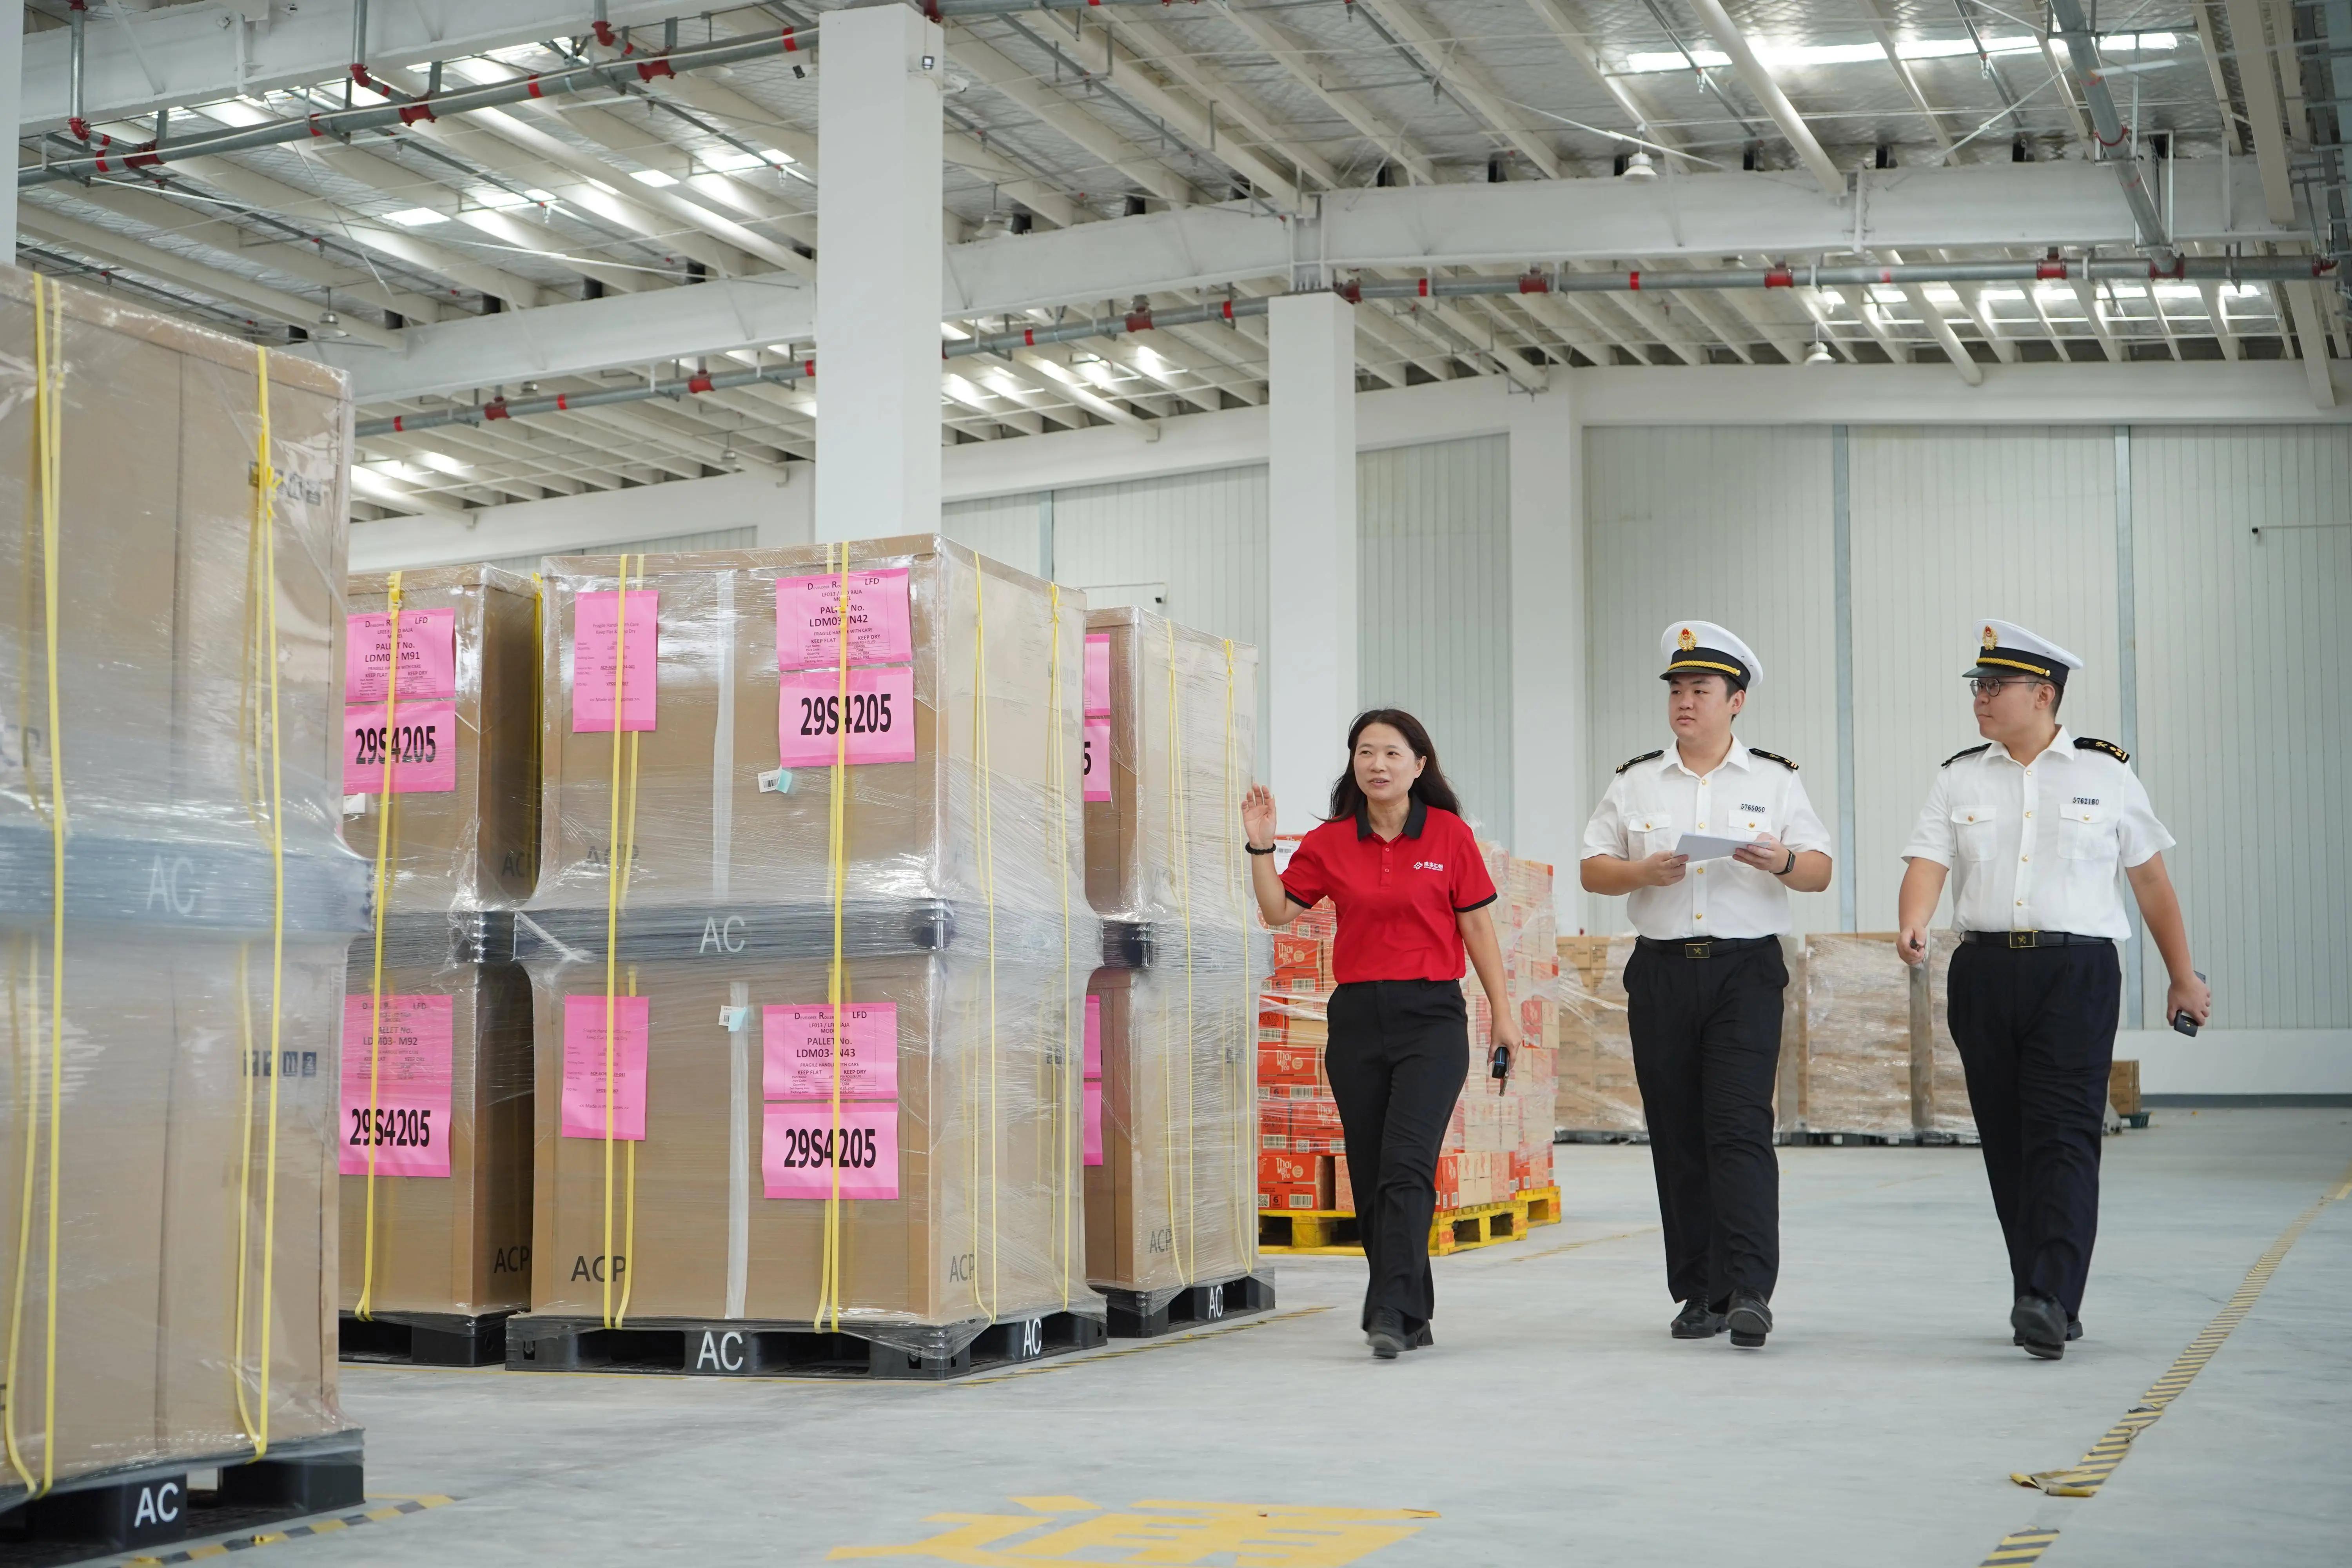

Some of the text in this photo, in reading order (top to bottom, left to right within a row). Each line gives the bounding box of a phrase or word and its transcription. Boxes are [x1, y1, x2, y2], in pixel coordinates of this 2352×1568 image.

[810, 615, 868, 627] LDM03 N42
[365, 652, 420, 662] LDM0- M91
[376, 642, 401, 650] PALLT
[800, 693, 891, 736] 29S4205
[356, 726, 436, 764] 29S4205
[1741, 804, 1765, 813] 5765050
[2073, 797, 2099, 805] 5762180
[146, 856, 194, 914] AC
[699, 915, 745, 954] AC
[1278, 942, 1293, 954] Thai
[399, 1037, 417, 1045] M92
[797, 1049, 833, 1058] LDM03-
[1276, 1050, 1292, 1062] Thai
[1316, 1103, 1332, 1115] Thai
[350, 1109, 431, 1147] 29S4205
[784, 1128, 876, 1168] 29S4205
[1276, 1157, 1292, 1169] Thai
[1149, 1229, 1172, 1254] ACP
[494, 1246, 530, 1274] ACP
[571, 1256, 626, 1282] ACP
[949, 1254, 975, 1283] ACP
[1209, 1285, 1223, 1319] AC
[696, 1331, 743, 1371] AC
[1023, 1318, 1042, 1357] AC
[134, 1482, 179, 1528] AC
[825, 1495, 1443, 1568] 通
